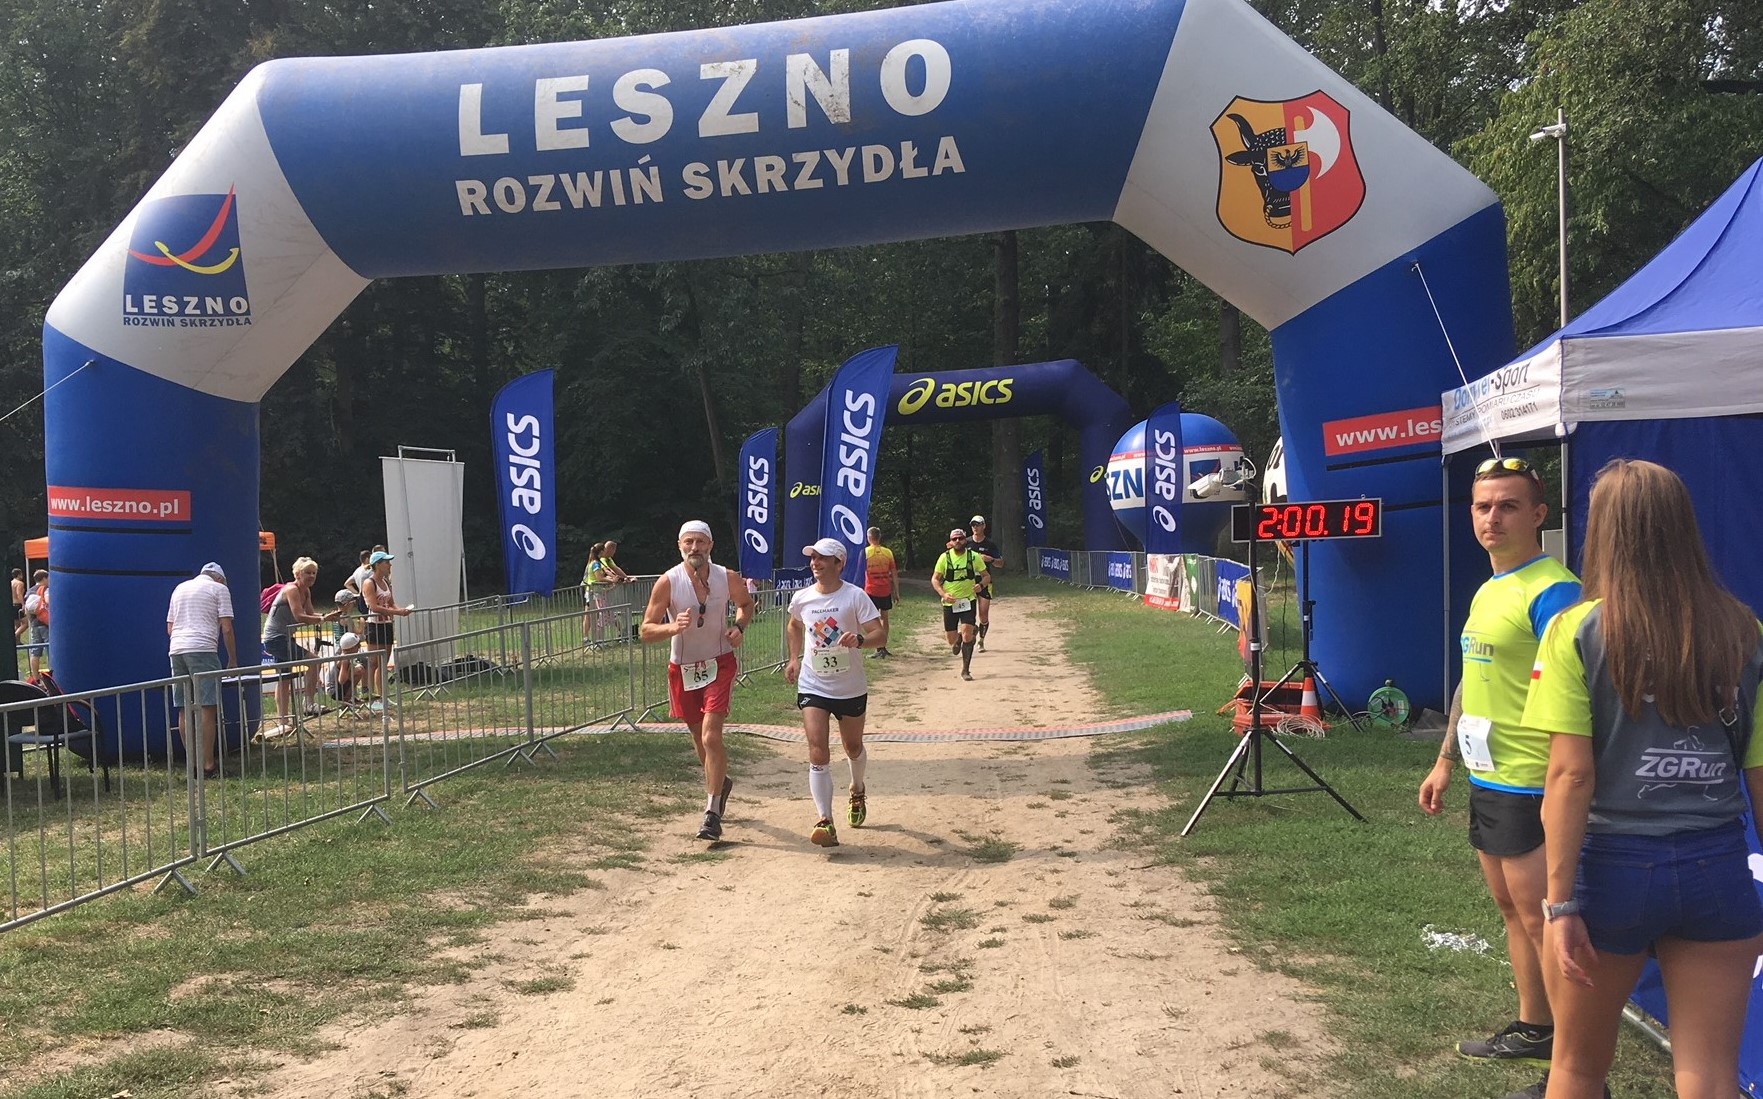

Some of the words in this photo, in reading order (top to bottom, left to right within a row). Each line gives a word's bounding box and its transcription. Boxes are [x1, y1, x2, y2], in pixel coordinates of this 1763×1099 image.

[458, 39, 952, 157] LESZNO
[456, 155, 664, 216] ROZWIŃ
[683, 136, 966, 200] SKRZYDŁA
[125, 294, 249, 315] LESZNO
[123, 315, 176, 328] ROZWIŃ
[180, 317, 252, 328] SKRZYDŁA
[802, 484, 821, 496] asi
[50, 496, 179, 517] www.leszno.pl
[823, 656, 838, 669] 33
[1635, 755, 1727, 778] ZGRun
